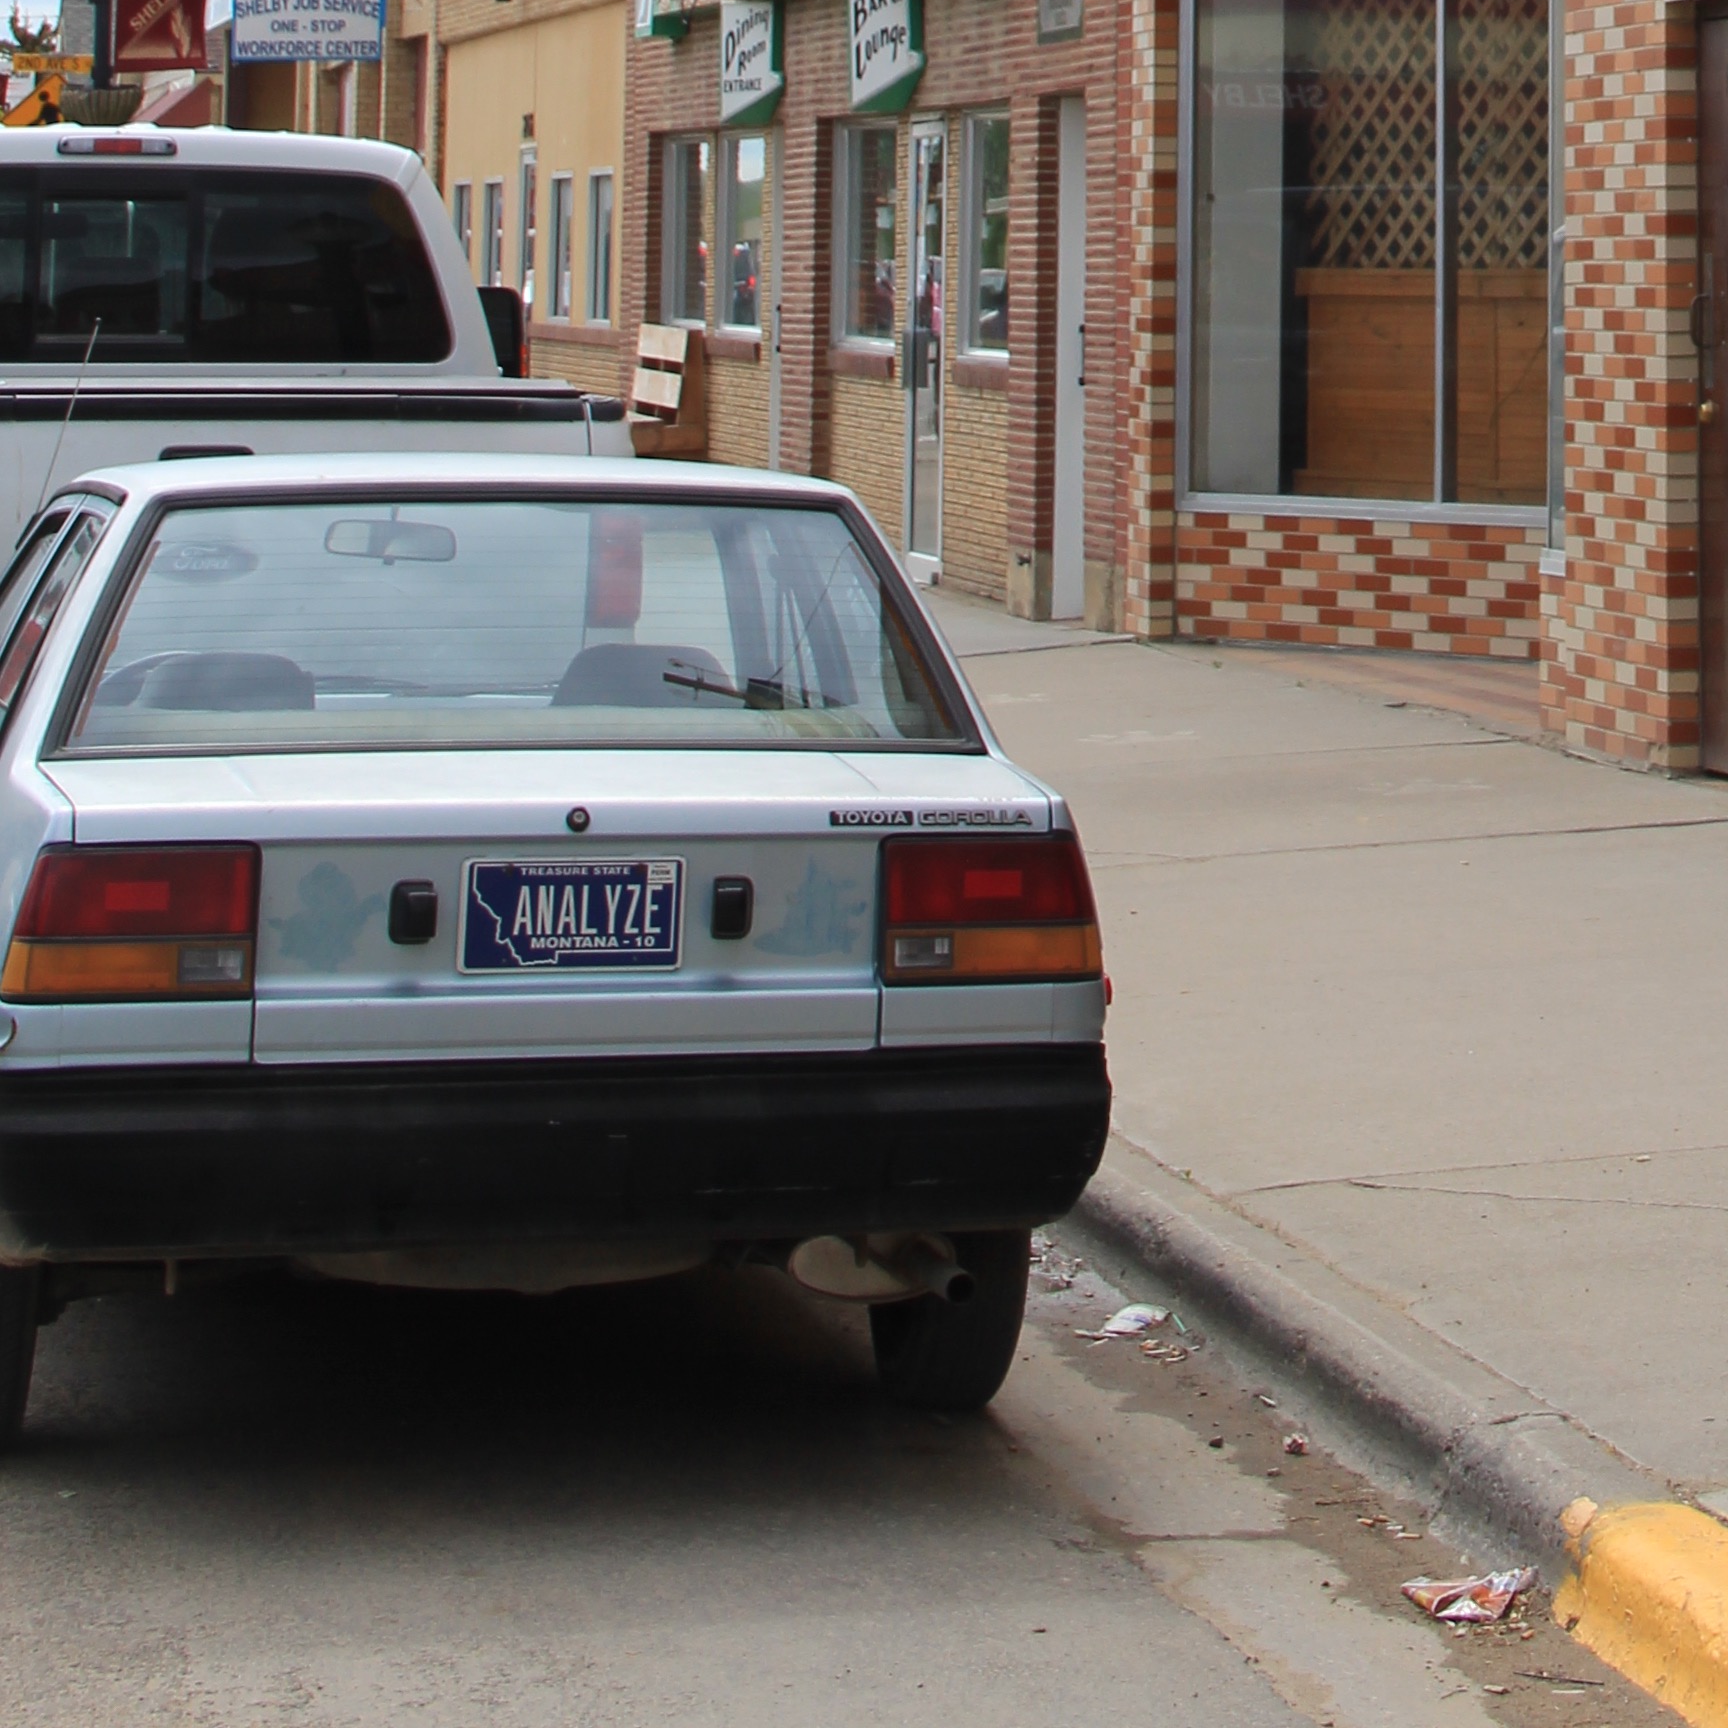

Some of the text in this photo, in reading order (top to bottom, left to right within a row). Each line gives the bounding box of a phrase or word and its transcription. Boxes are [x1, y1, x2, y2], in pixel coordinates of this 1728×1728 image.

[270, 19, 299, 33] ONE
[310, 19, 346, 33] STOP
[724, 7, 770, 73] Dining
[236, 41, 378, 57] WORKFORCE CENTER
[855, 23, 907, 80] Lounge
[737, 40, 766, 77] Room
[723, 77, 763, 94] ENTRANCE
[835, 809, 1033, 825] TOYOTA COROLLA
[520, 866, 631, 876] TREASURE STATE
[512, 884, 664, 936] ANALYZE
[529, 935, 620, 950] MONTANA
[634, 935, 656, 948] 10
